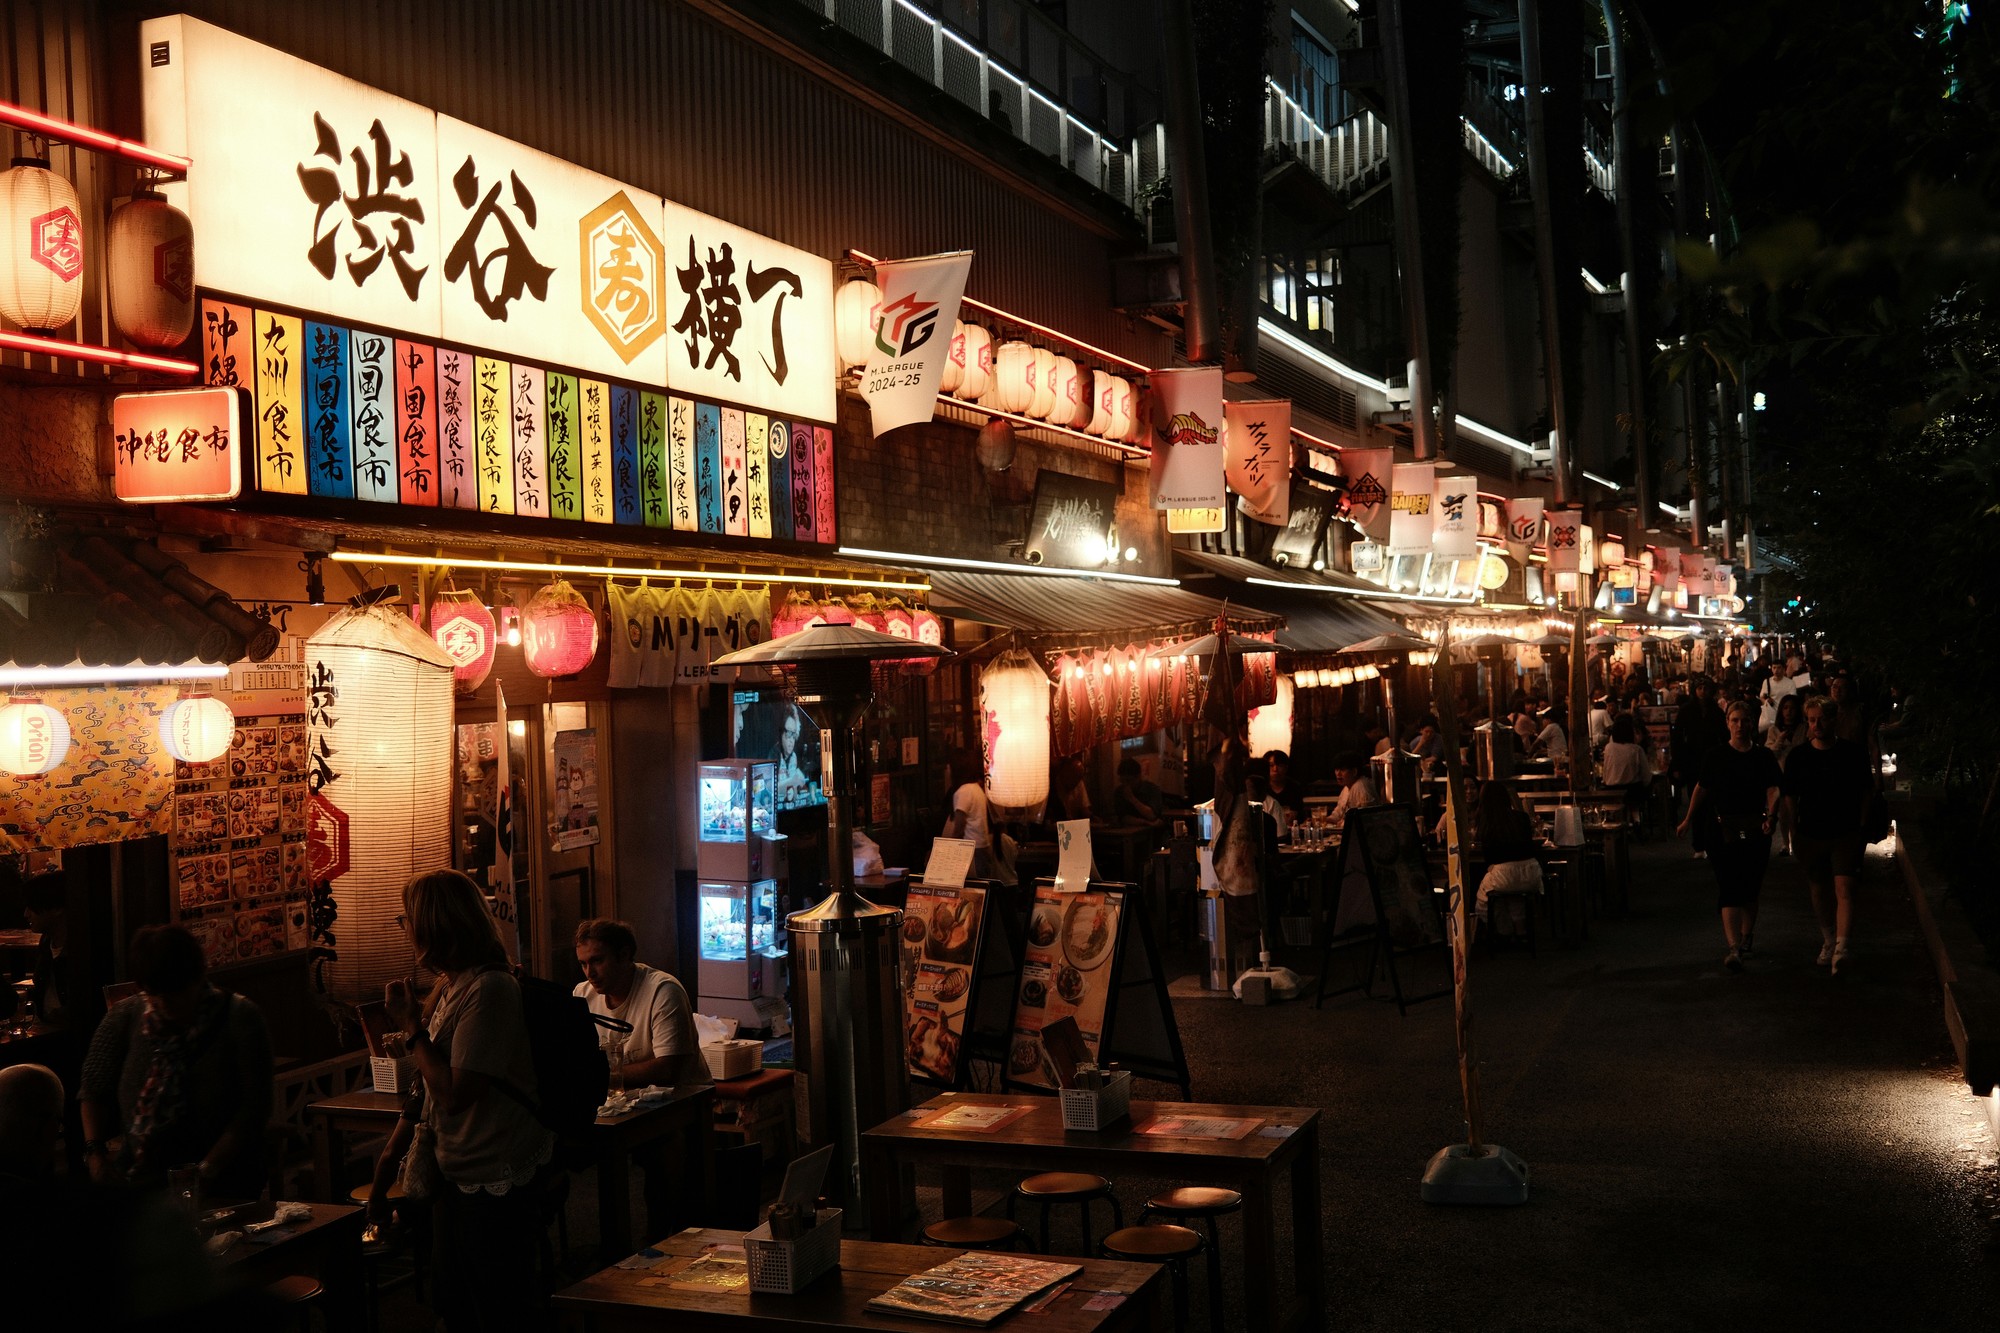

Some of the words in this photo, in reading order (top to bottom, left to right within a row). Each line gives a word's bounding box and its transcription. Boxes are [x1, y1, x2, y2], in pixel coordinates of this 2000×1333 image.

[297, 111, 557, 322] 渋谷
[671, 234, 803, 387] 横丁
[261, 315, 294, 489] 九州食市
[311, 327, 344, 490] 韓国食市
[355, 335, 391, 498] 四国食市
[401, 344, 432, 500] 中国食市
[869, 373, 921, 393] 2024-25
[871, 362, 924, 376] M.LEAGUE
[116, 425, 230, 466] 沖縄食市
[515, 369, 539, 514] 東海食市
[550, 375, 574, 517] 北陸食市
[586, 382, 605, 520] 横浜中華食市
[615, 390, 635, 521] 関東食市
[643, 395, 663, 524] 東北食市
[672, 400, 689, 527] 北海道食市
[1392, 494, 1431, 511] RAIDEN
[652, 612, 741, 652] Mリーグ
[27, 716, 49, 763] Orion
